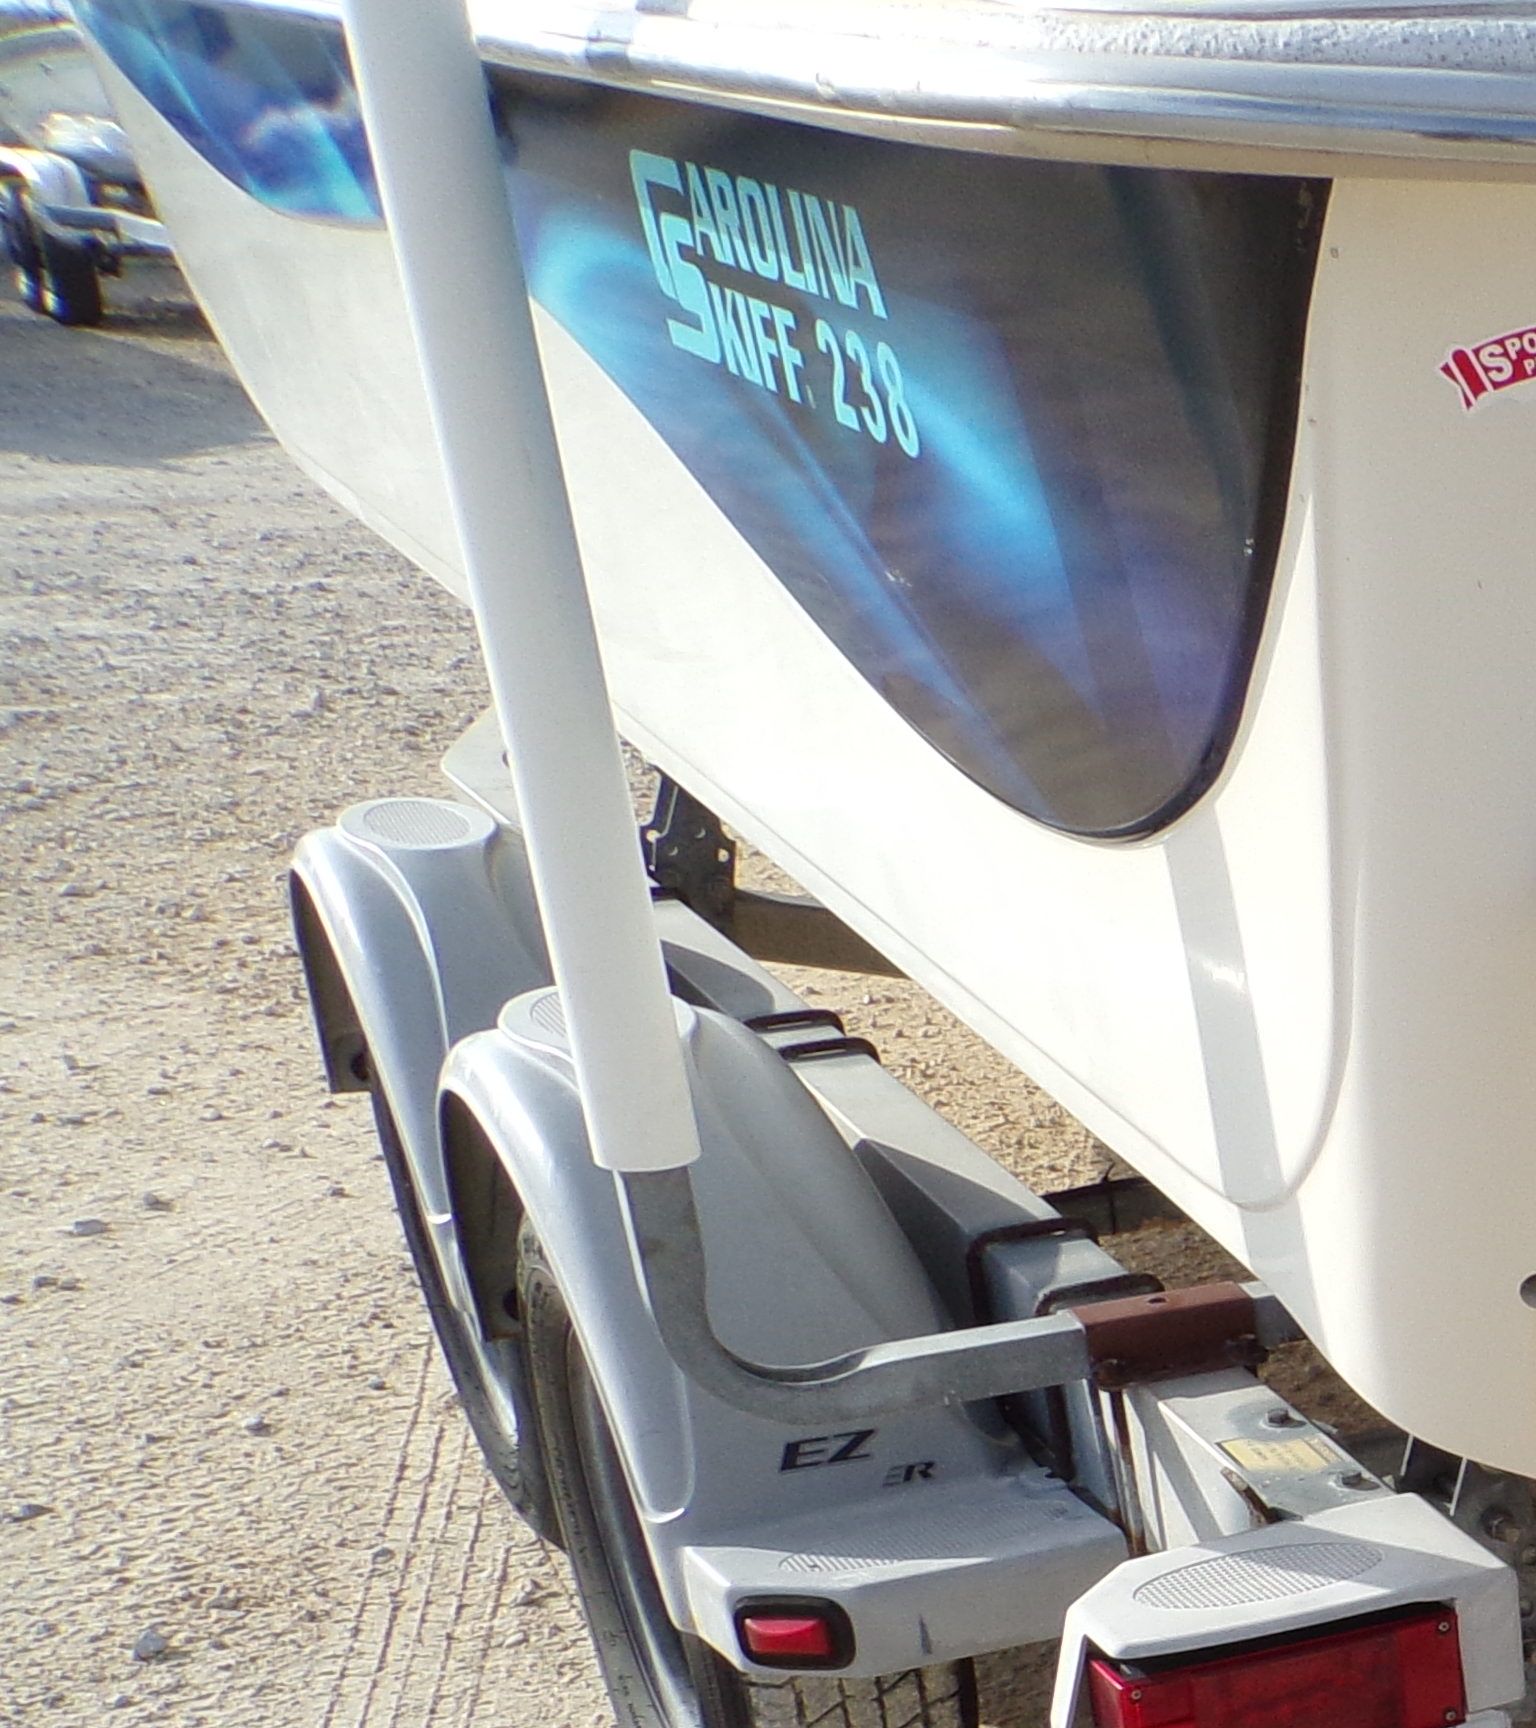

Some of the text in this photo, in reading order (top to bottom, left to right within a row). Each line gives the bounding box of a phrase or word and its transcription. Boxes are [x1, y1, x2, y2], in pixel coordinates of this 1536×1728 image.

[629, 149, 888, 320] CAROLINA
[660, 213, 920, 458] SKIFF 238
[780, 1429, 877, 1472] EZ
